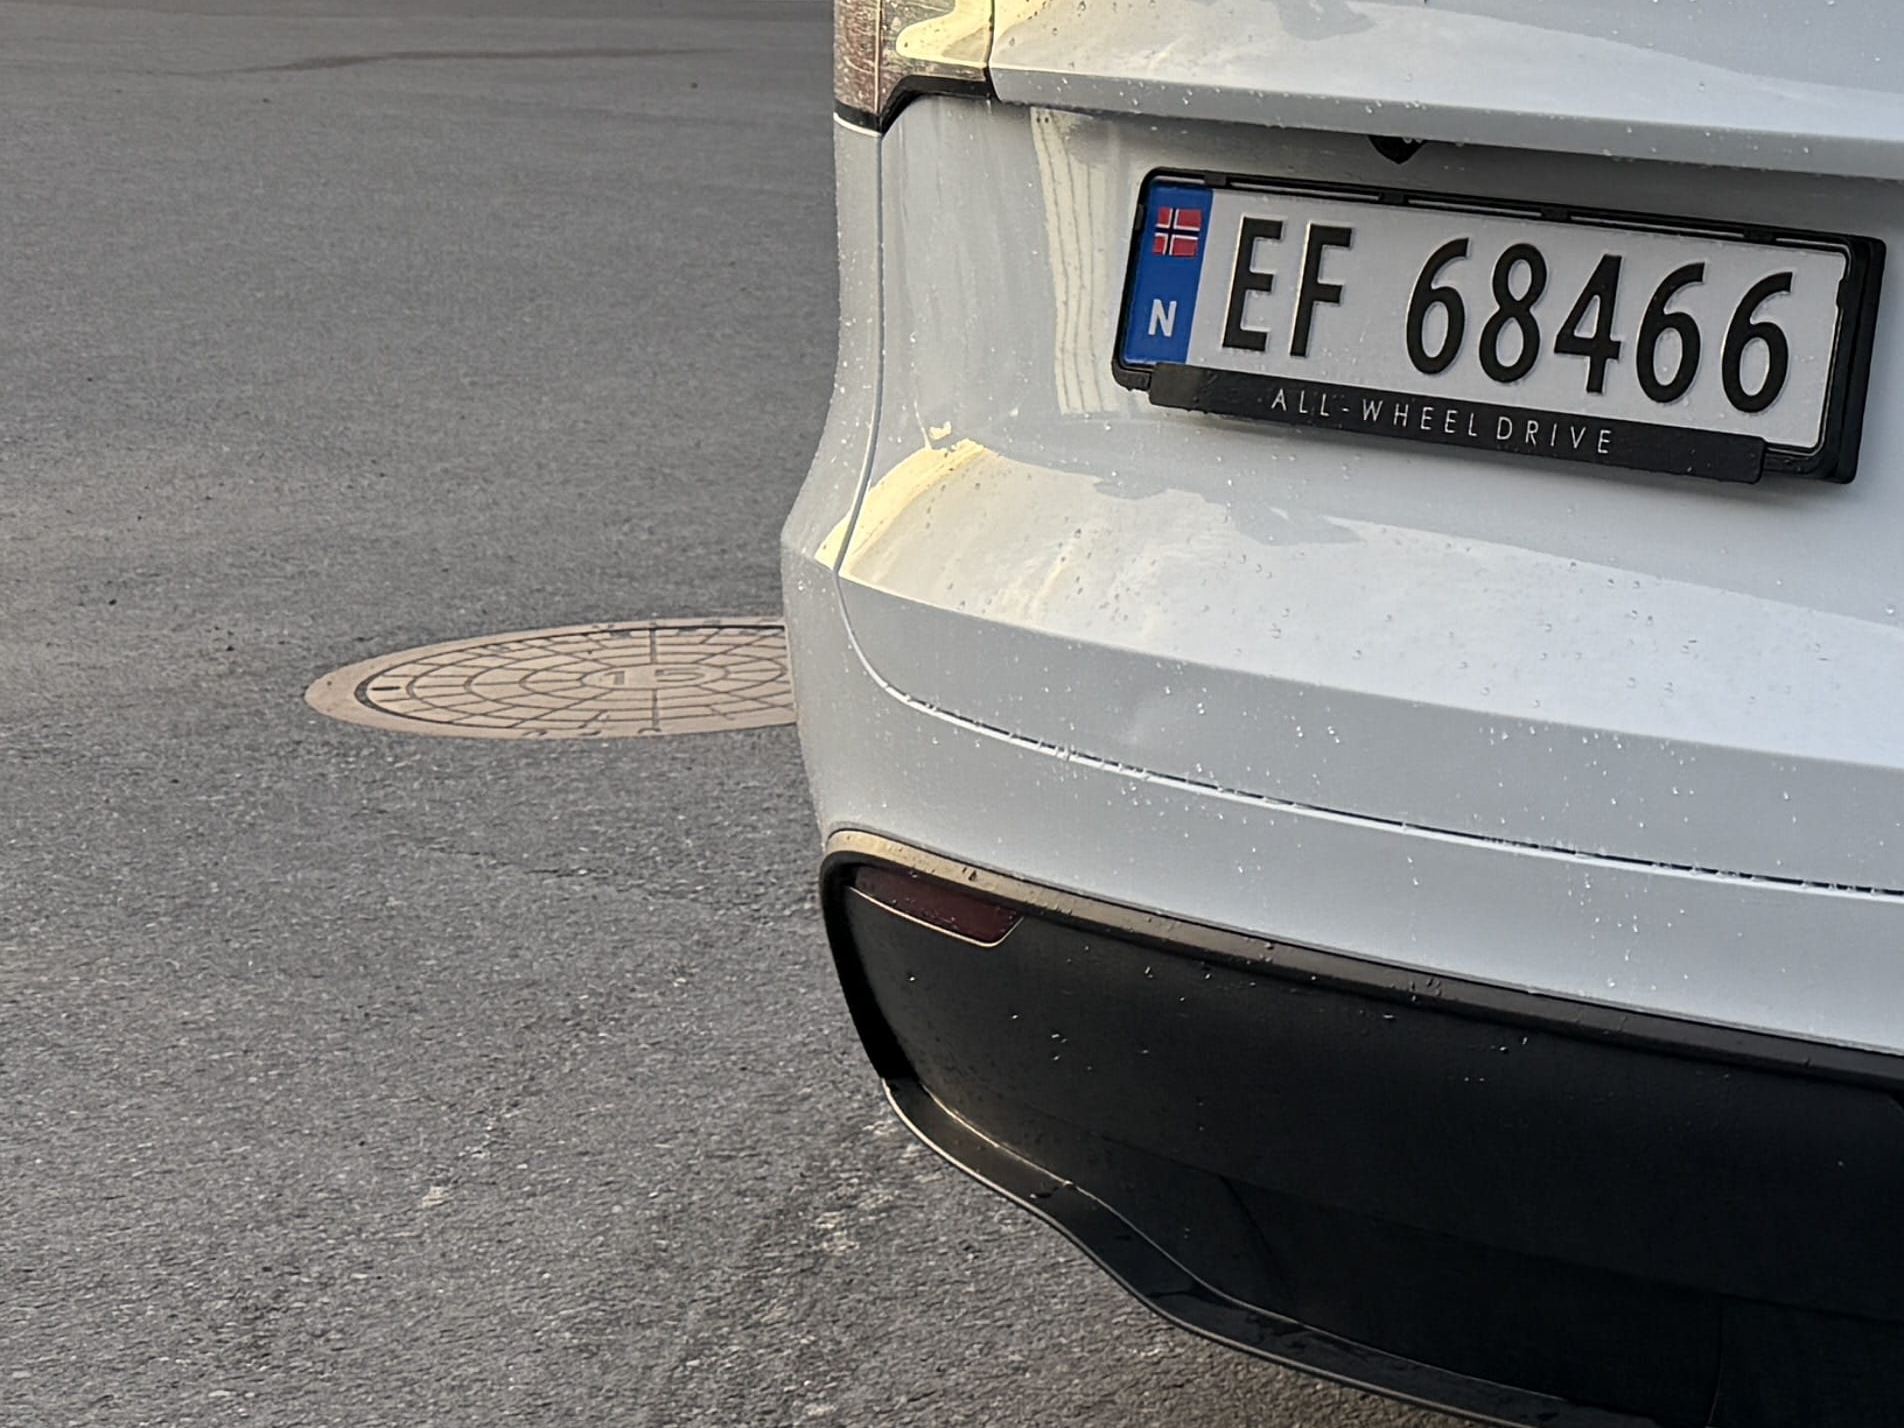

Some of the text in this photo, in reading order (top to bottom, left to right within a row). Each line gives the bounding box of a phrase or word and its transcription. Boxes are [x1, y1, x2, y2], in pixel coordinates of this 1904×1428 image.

[1148, 299, 1177, 338] N
[1221, 215, 1794, 414] EF 68466
